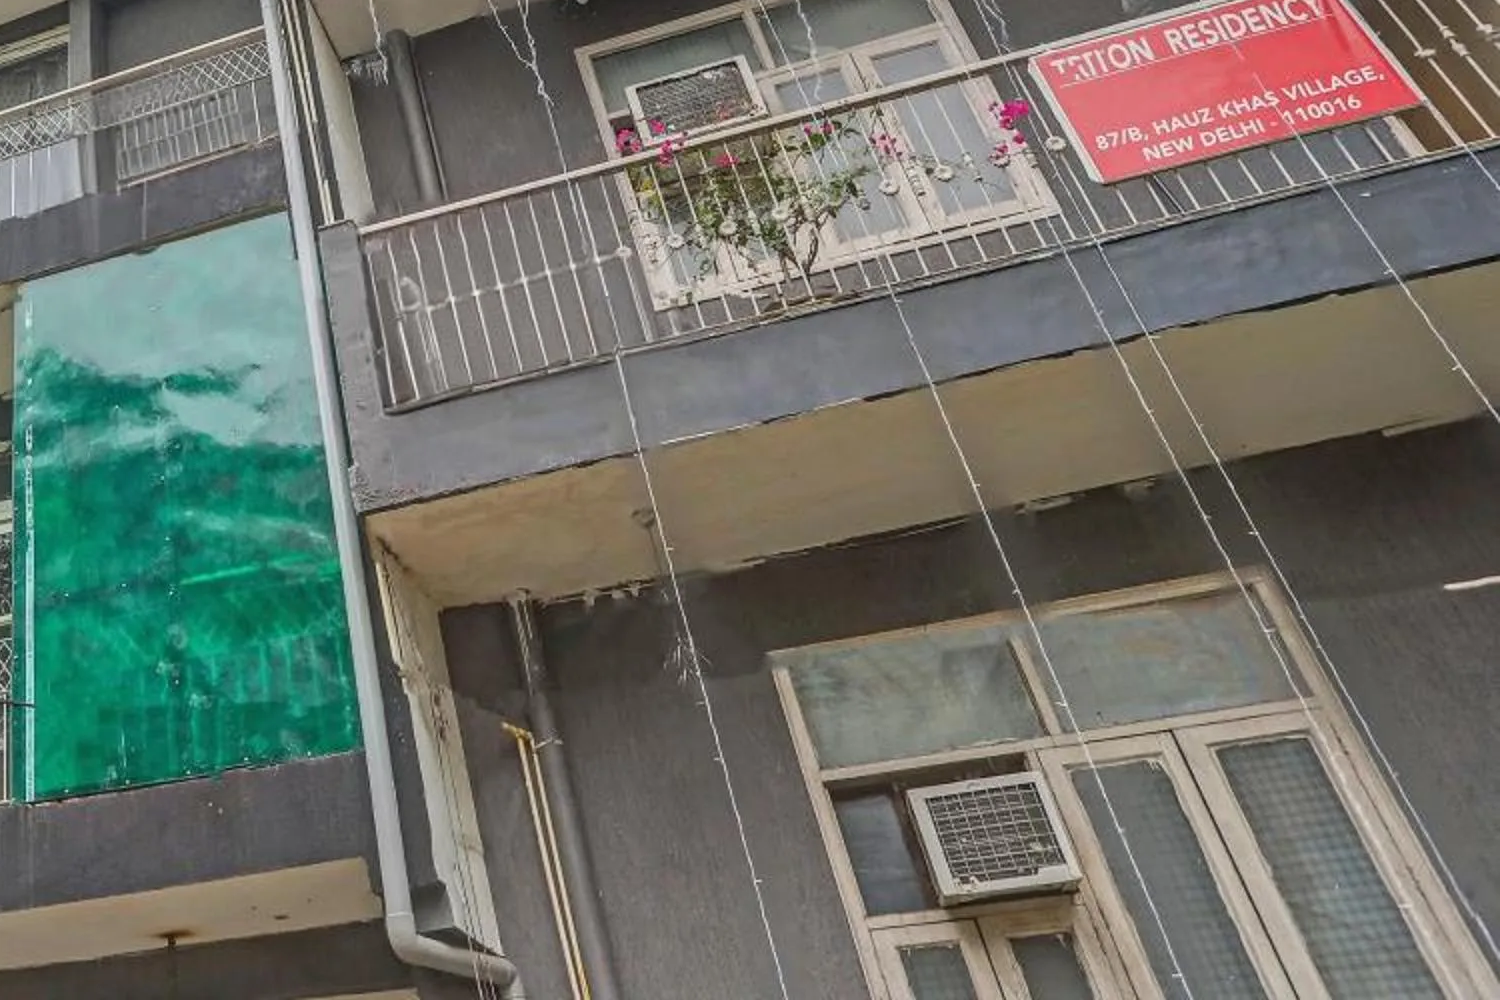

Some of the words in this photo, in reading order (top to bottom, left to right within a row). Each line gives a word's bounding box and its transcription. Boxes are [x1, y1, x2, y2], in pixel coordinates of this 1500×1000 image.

[1095, 125, 1150, 151] 87/B,
[1152, 107, 1214, 136] HAUZ
[1217, 91, 1280, 119] KHAS
[1282, 65, 1385, 100] VILLAGE,
[1142, 135, 1194, 161] NEW
[1199, 118, 1266, 148] DELHI
[1283, 94, 1363, 126] 110016
